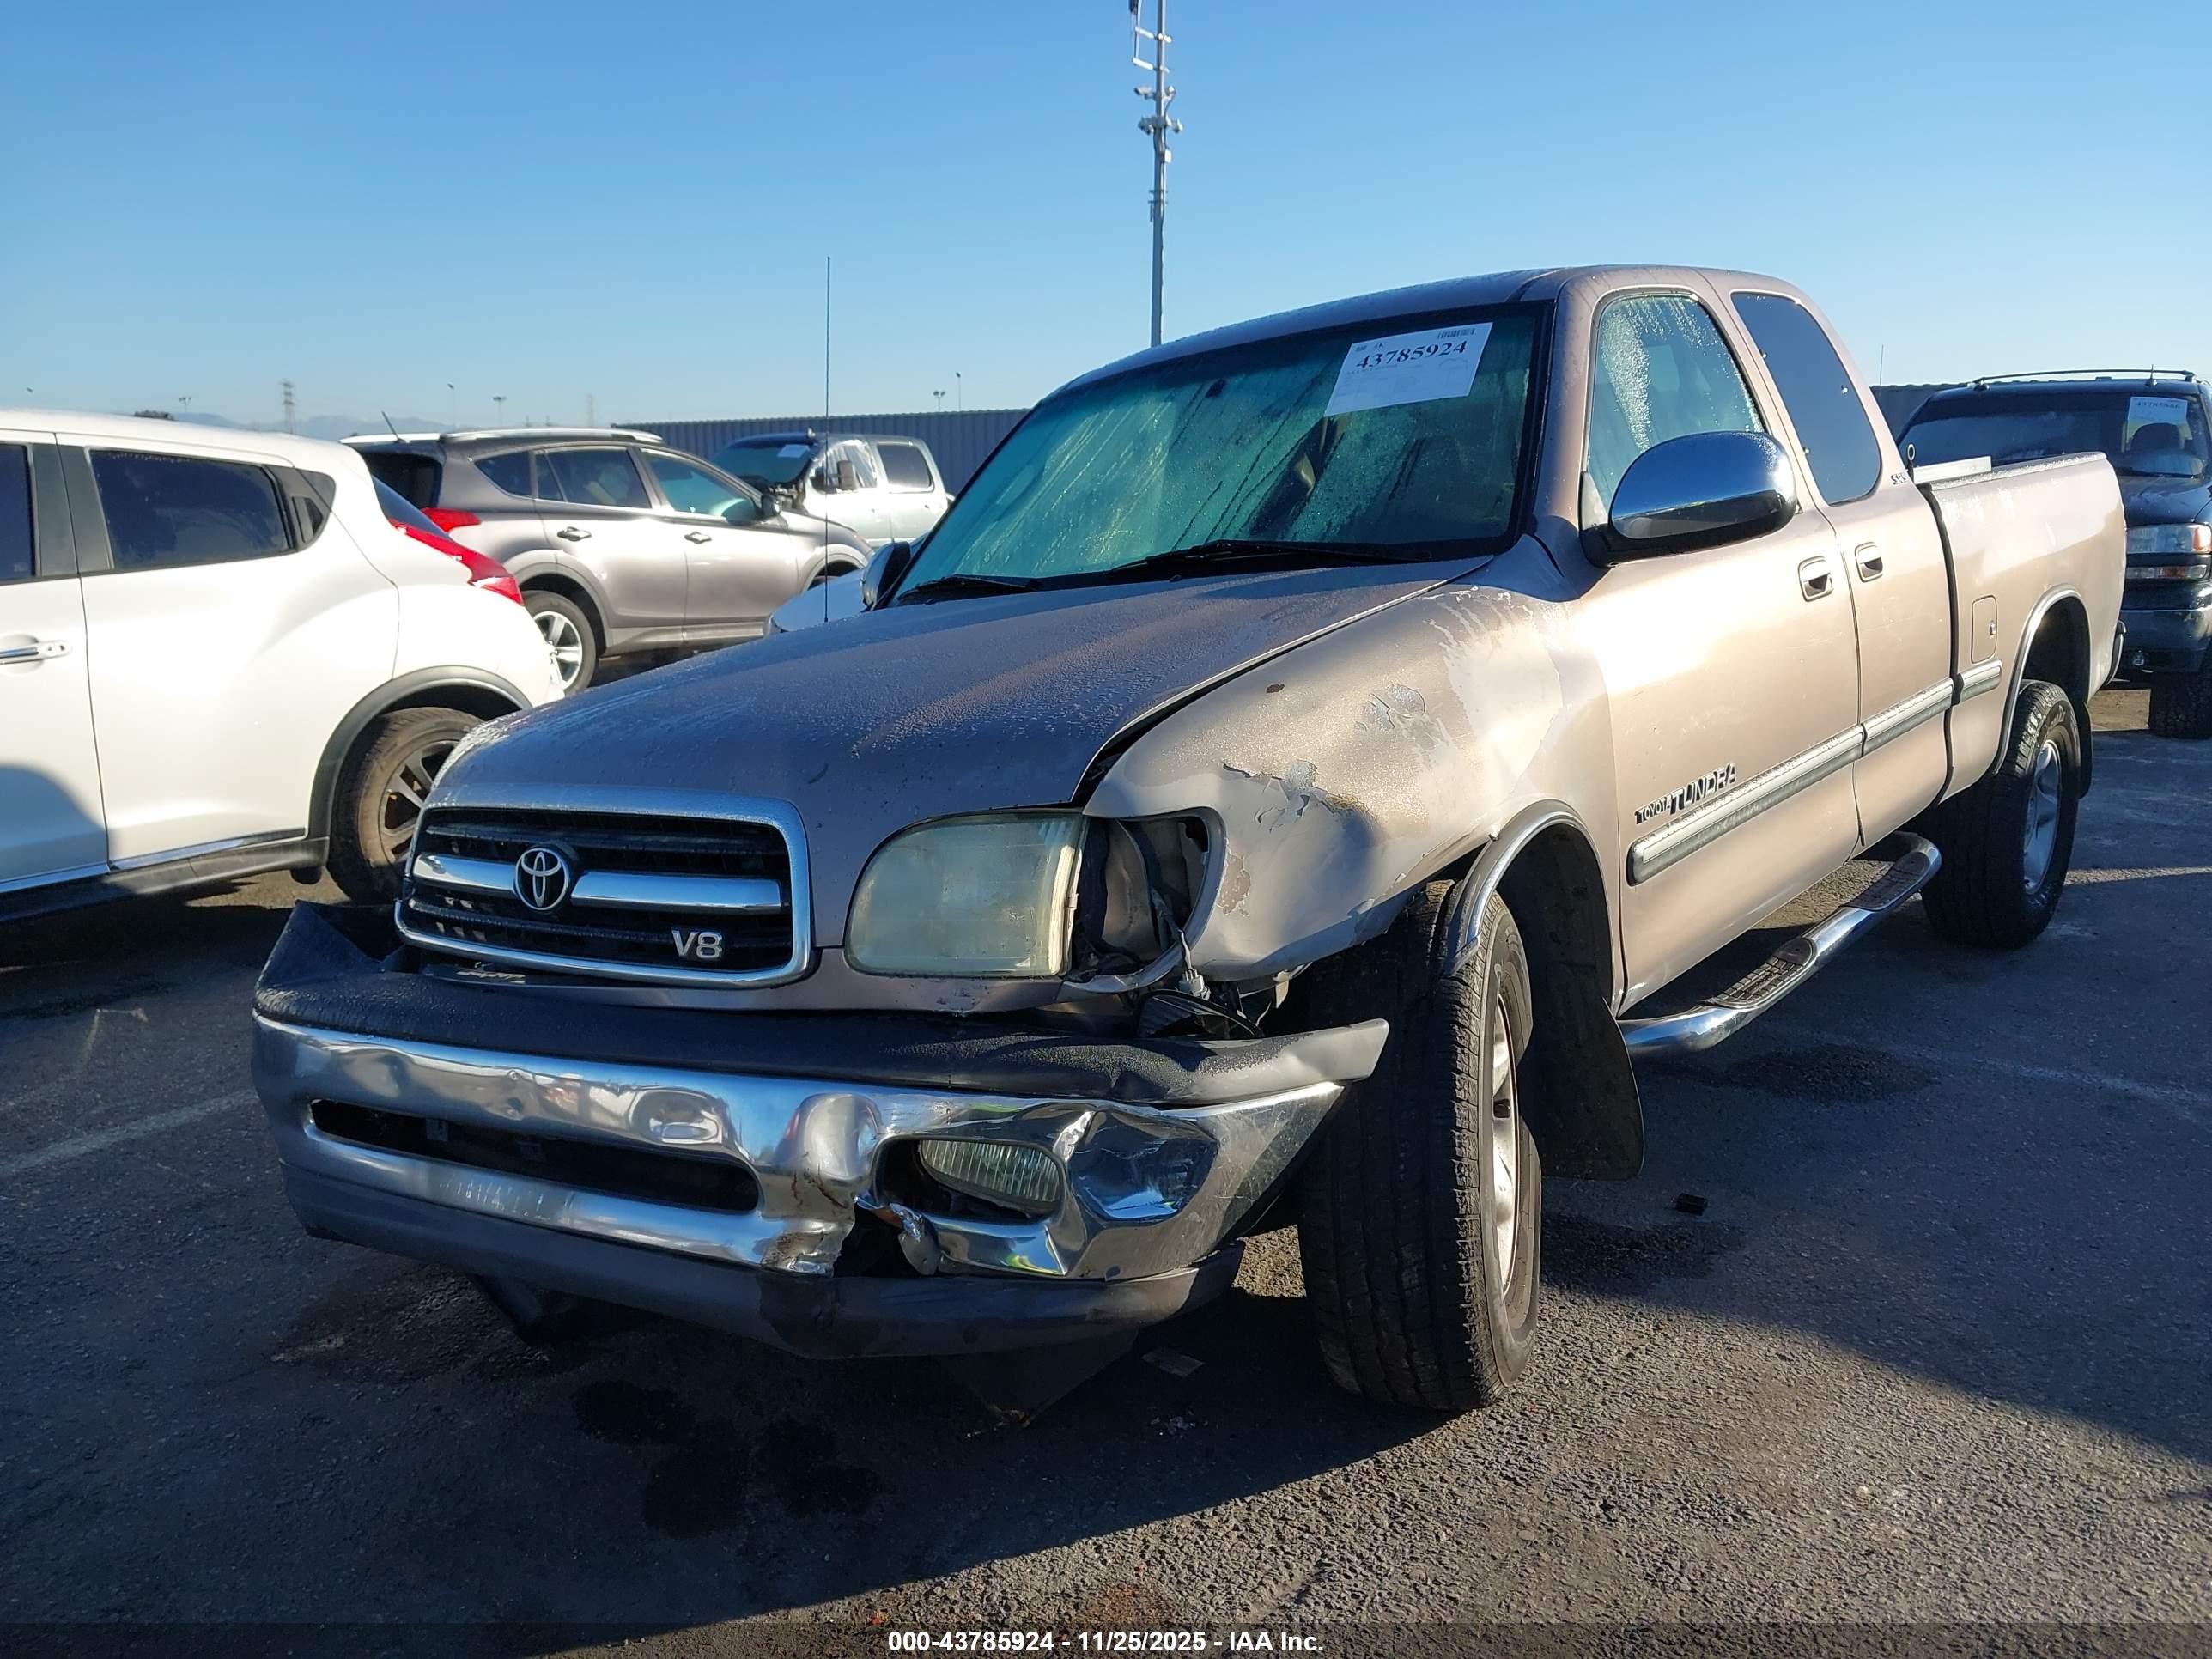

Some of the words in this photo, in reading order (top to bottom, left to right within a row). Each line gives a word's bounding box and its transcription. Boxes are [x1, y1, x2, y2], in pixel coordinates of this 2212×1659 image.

[1356, 340, 1467, 368] 43785924
[1634, 795, 1673, 824] TOYOTA
[1669, 762, 1736, 815] TUNDRA
[672, 928, 722, 958] V8
